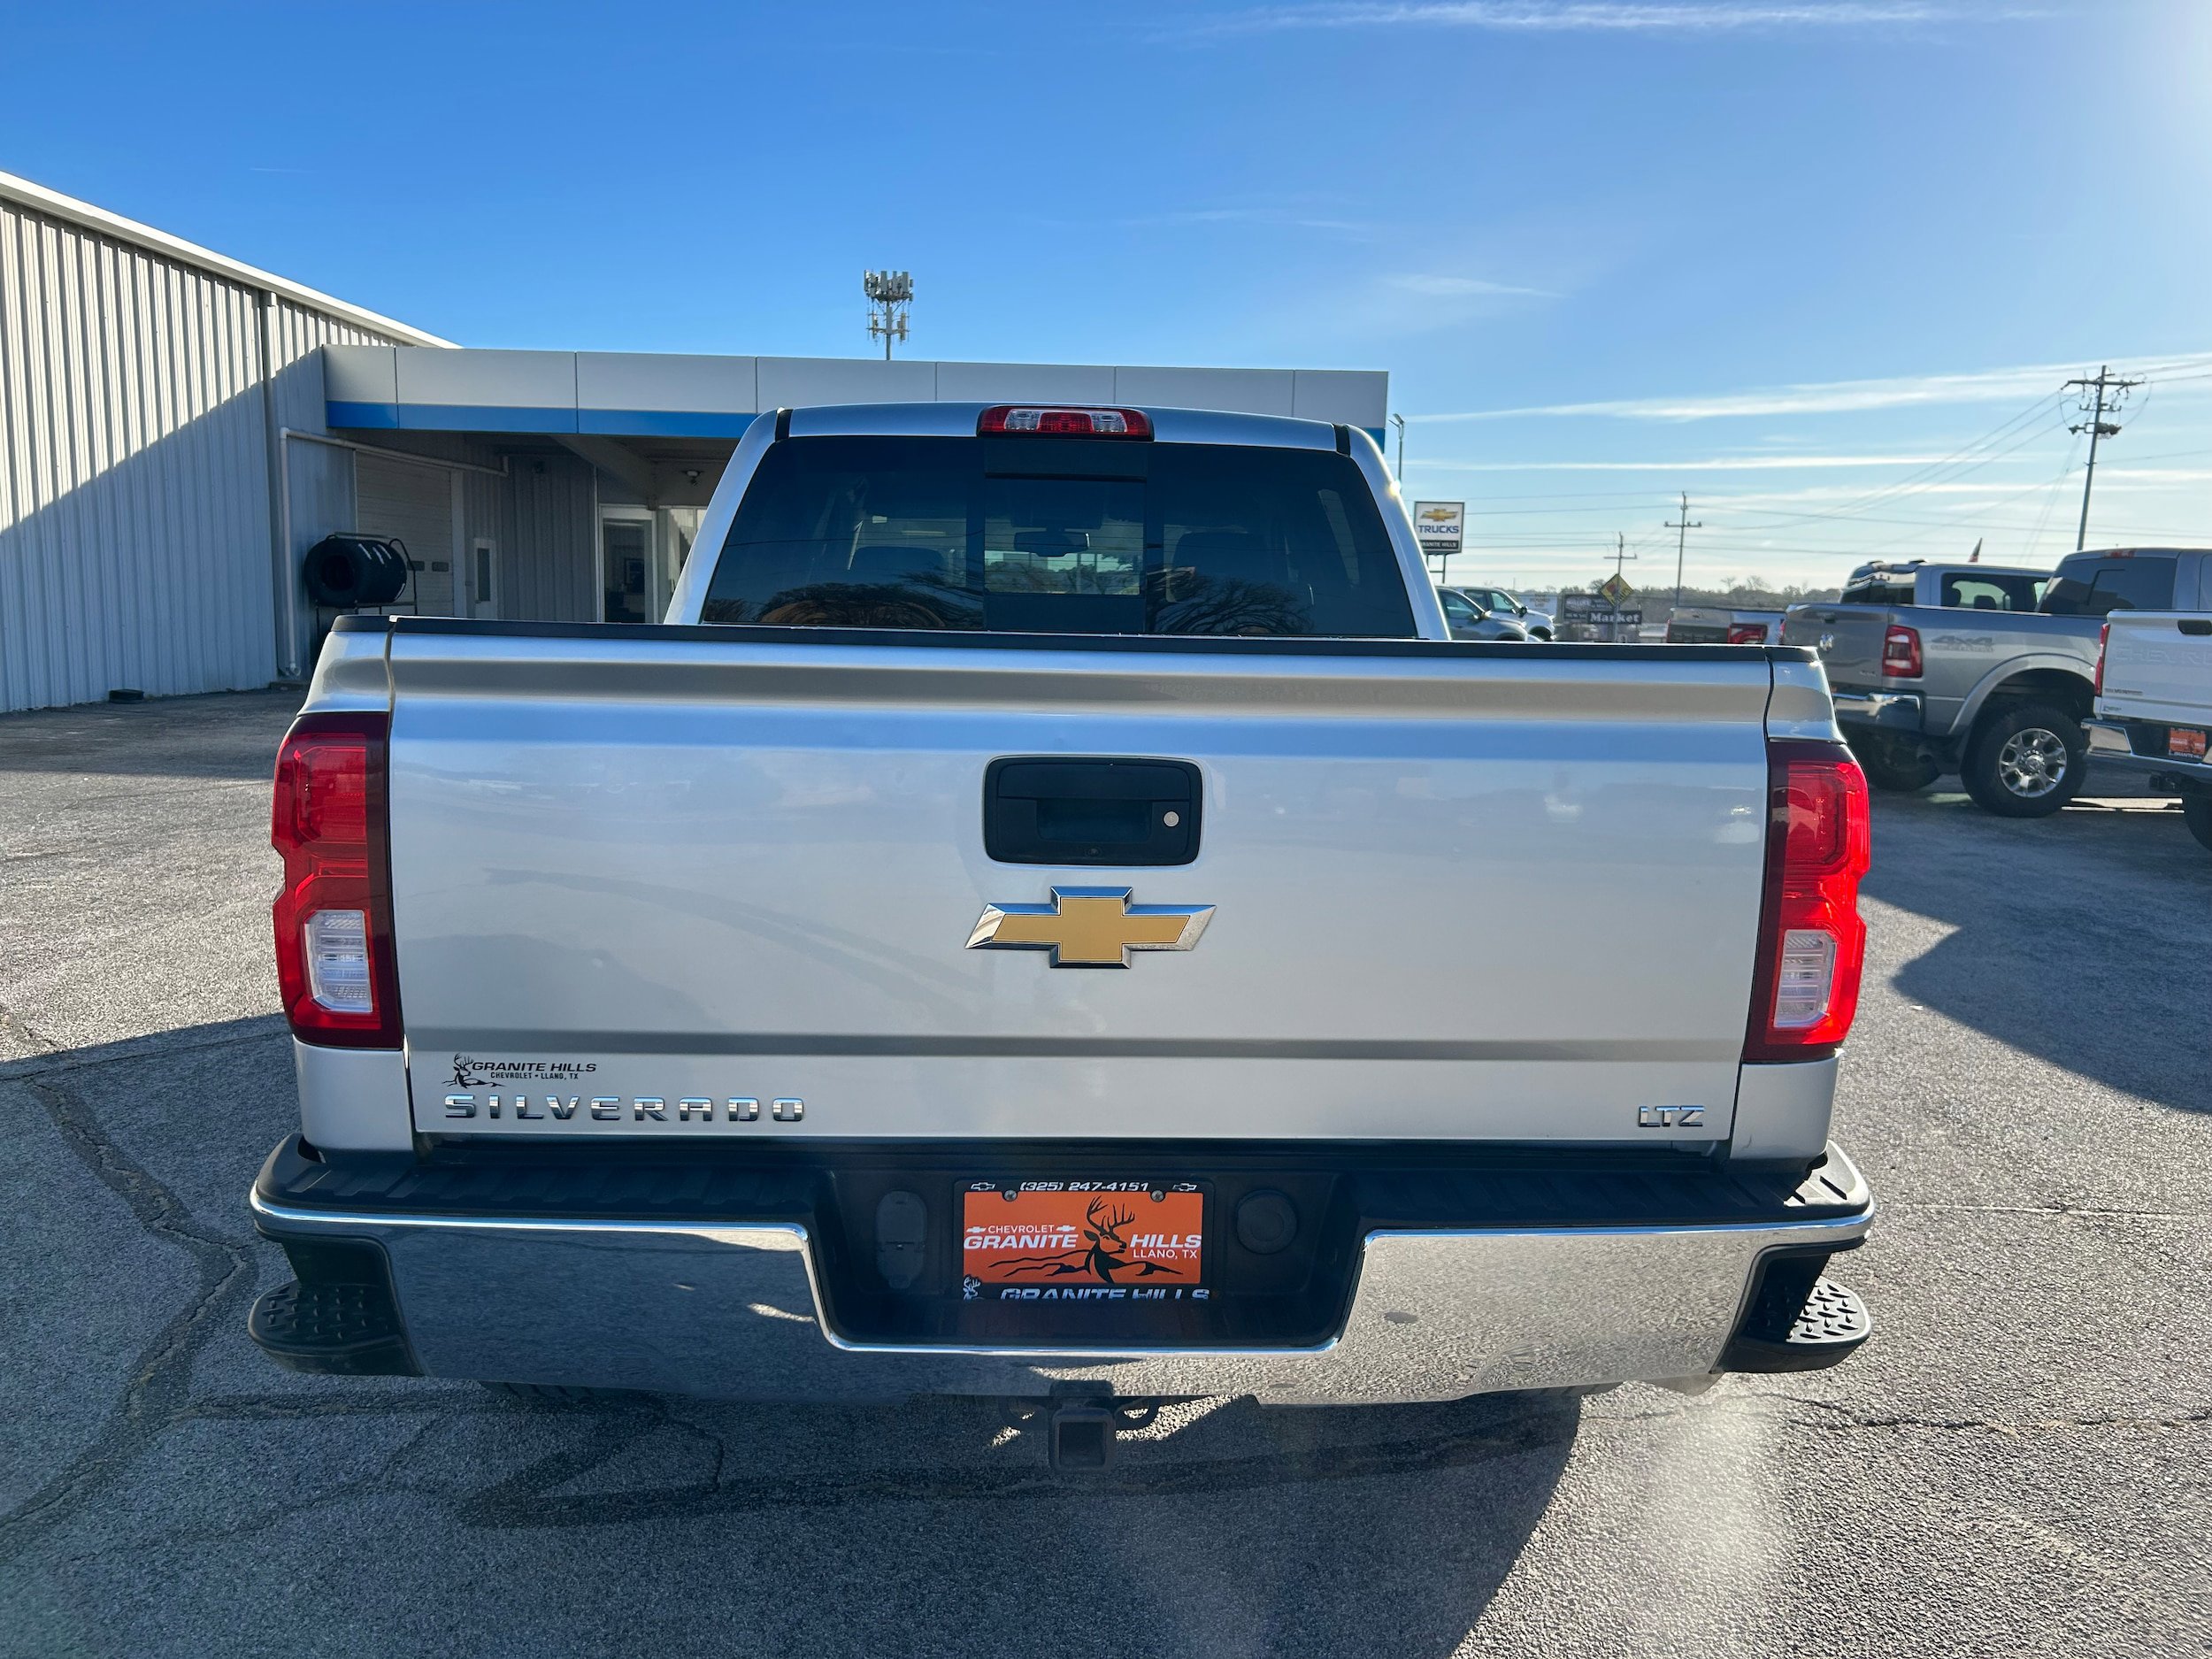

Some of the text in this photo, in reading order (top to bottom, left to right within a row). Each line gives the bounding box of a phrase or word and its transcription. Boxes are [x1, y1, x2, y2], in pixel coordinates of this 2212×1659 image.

[1590, 611, 1639, 622] Market
[472, 1062, 597, 1071] GRANITE HILLS
[444, 1094, 805, 1122] SILVERADO
[1639, 1105, 1705, 1127] LTZ
[1019, 1181, 1148, 1192] (325) 247-4151
[987, 1225, 1055, 1233] CHEVROLET
[963, 1233, 1202, 1249] GRANITE HILLS
[1133, 1248, 1197, 1260] LLANO, TX
